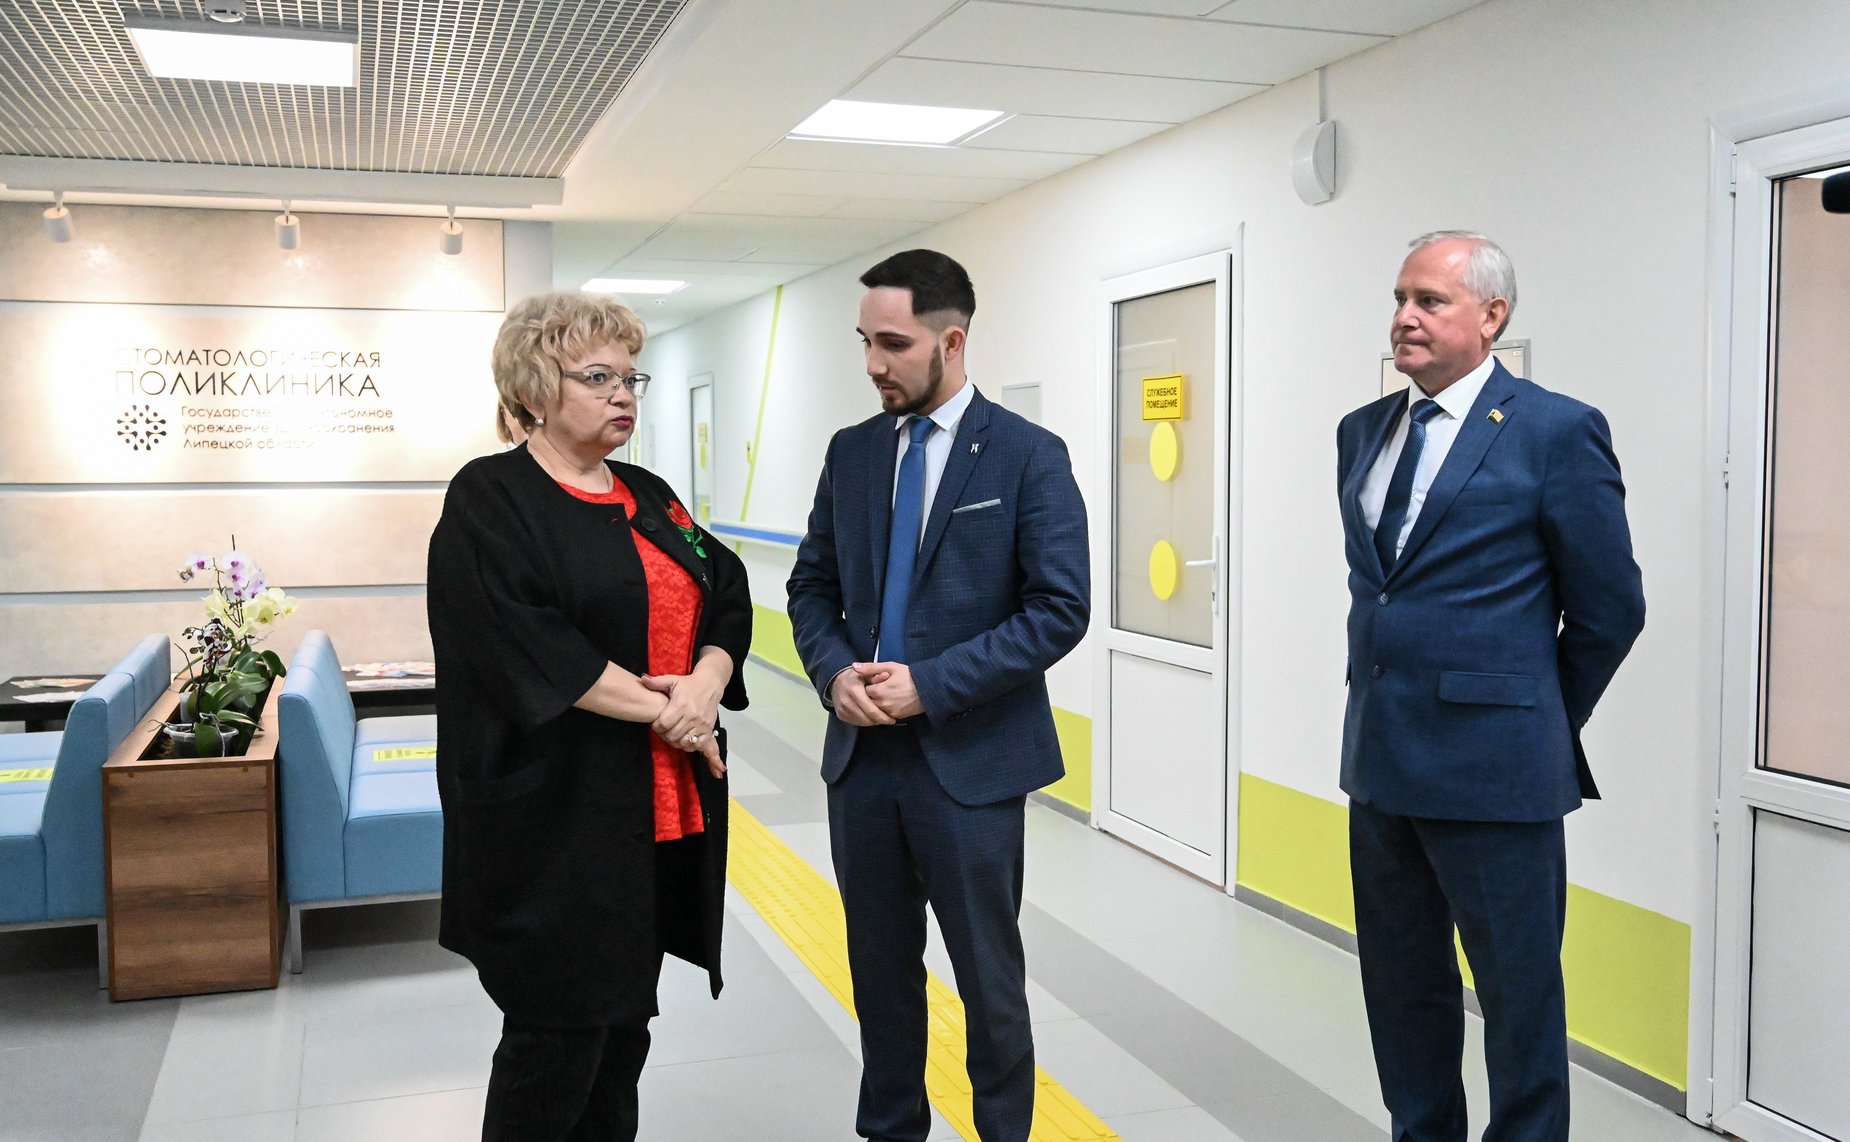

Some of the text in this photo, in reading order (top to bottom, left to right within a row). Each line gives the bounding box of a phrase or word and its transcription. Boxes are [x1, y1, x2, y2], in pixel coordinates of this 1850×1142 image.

[115, 348, 381, 369] ТОМАТОЛОГИЕСКАЯ
[115, 370, 380, 397] ПОЛИКЛИНИКА
[1146, 387, 1178, 397] СЛУЖЕБНОЕ
[1146, 399, 1178, 408] ПОМЕЩЕНИЕ
[181, 406, 300, 419] Государстве
[183, 438, 253, 449] Липецкой
